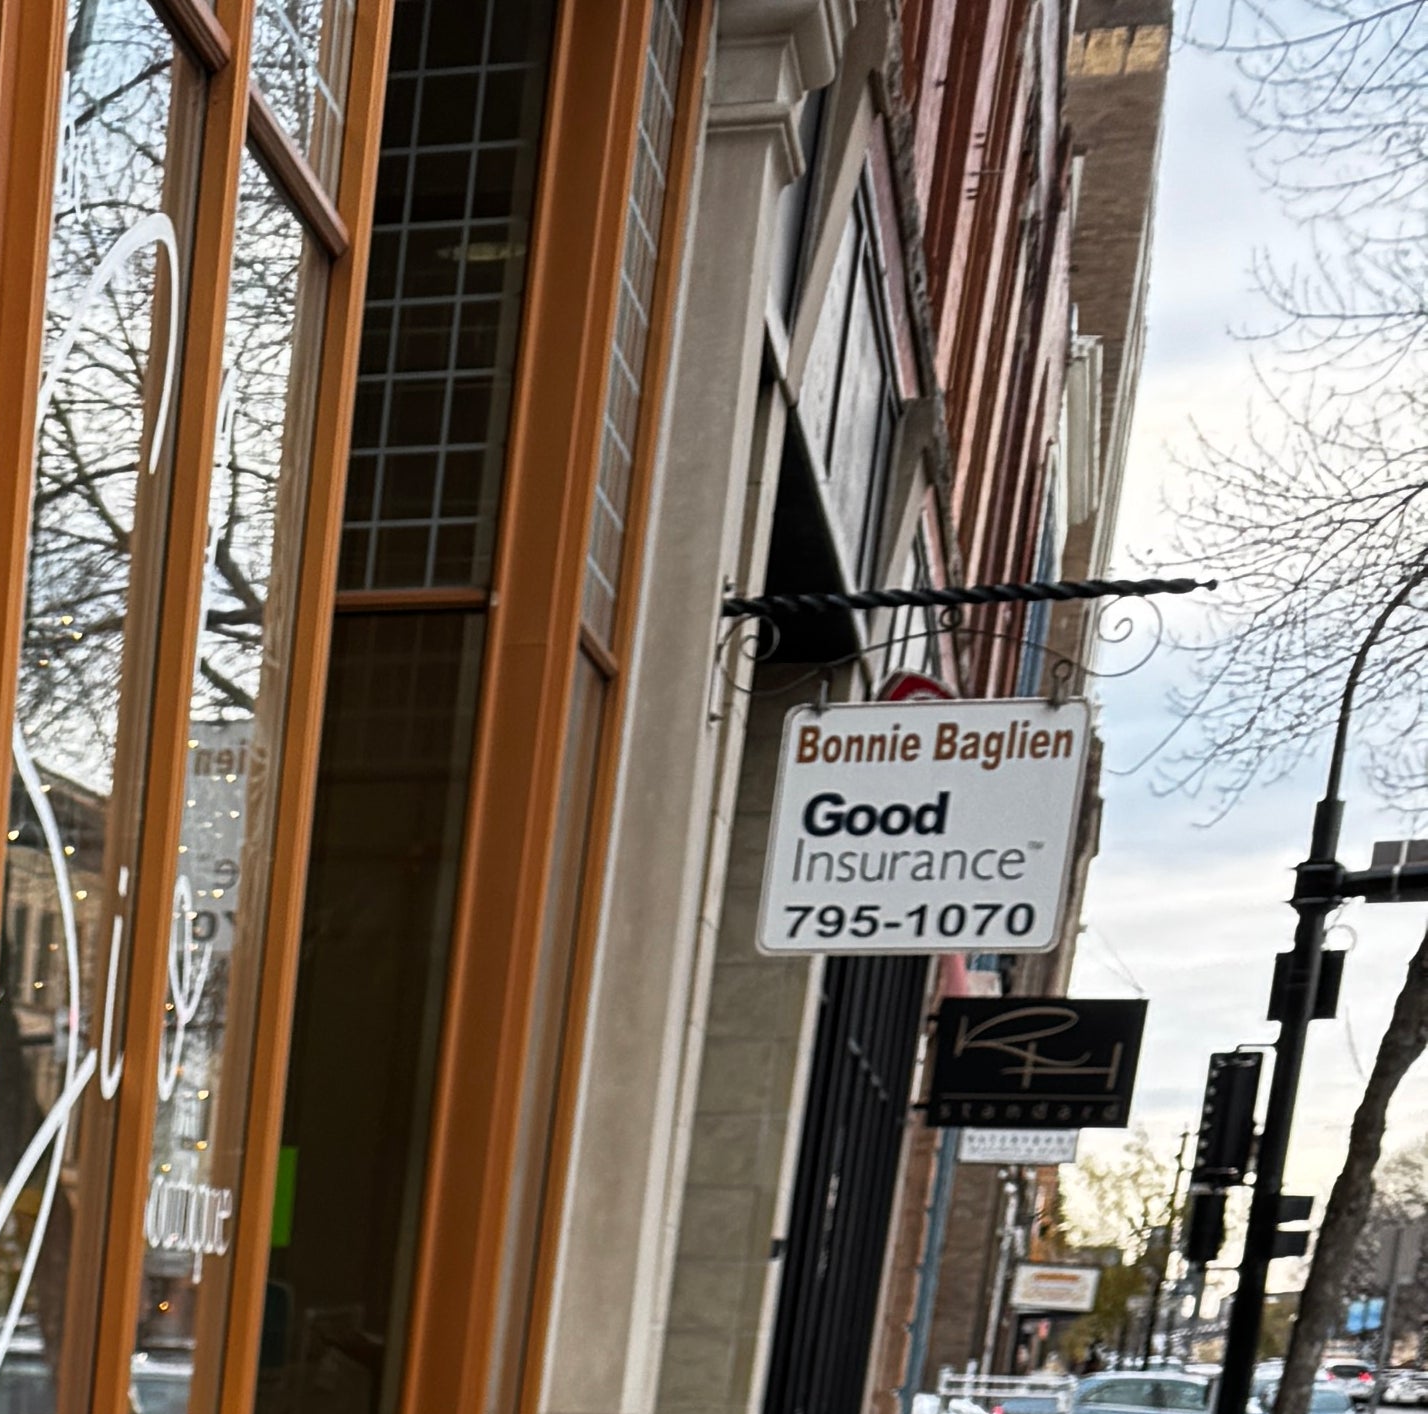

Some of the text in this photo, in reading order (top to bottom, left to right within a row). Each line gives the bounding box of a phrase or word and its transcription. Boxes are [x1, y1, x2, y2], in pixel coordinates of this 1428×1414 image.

[796, 721, 1074, 770] Bonnie Baglien
[803, 791, 951, 837] Good
[784, 903, 1035, 939] 795-1070
